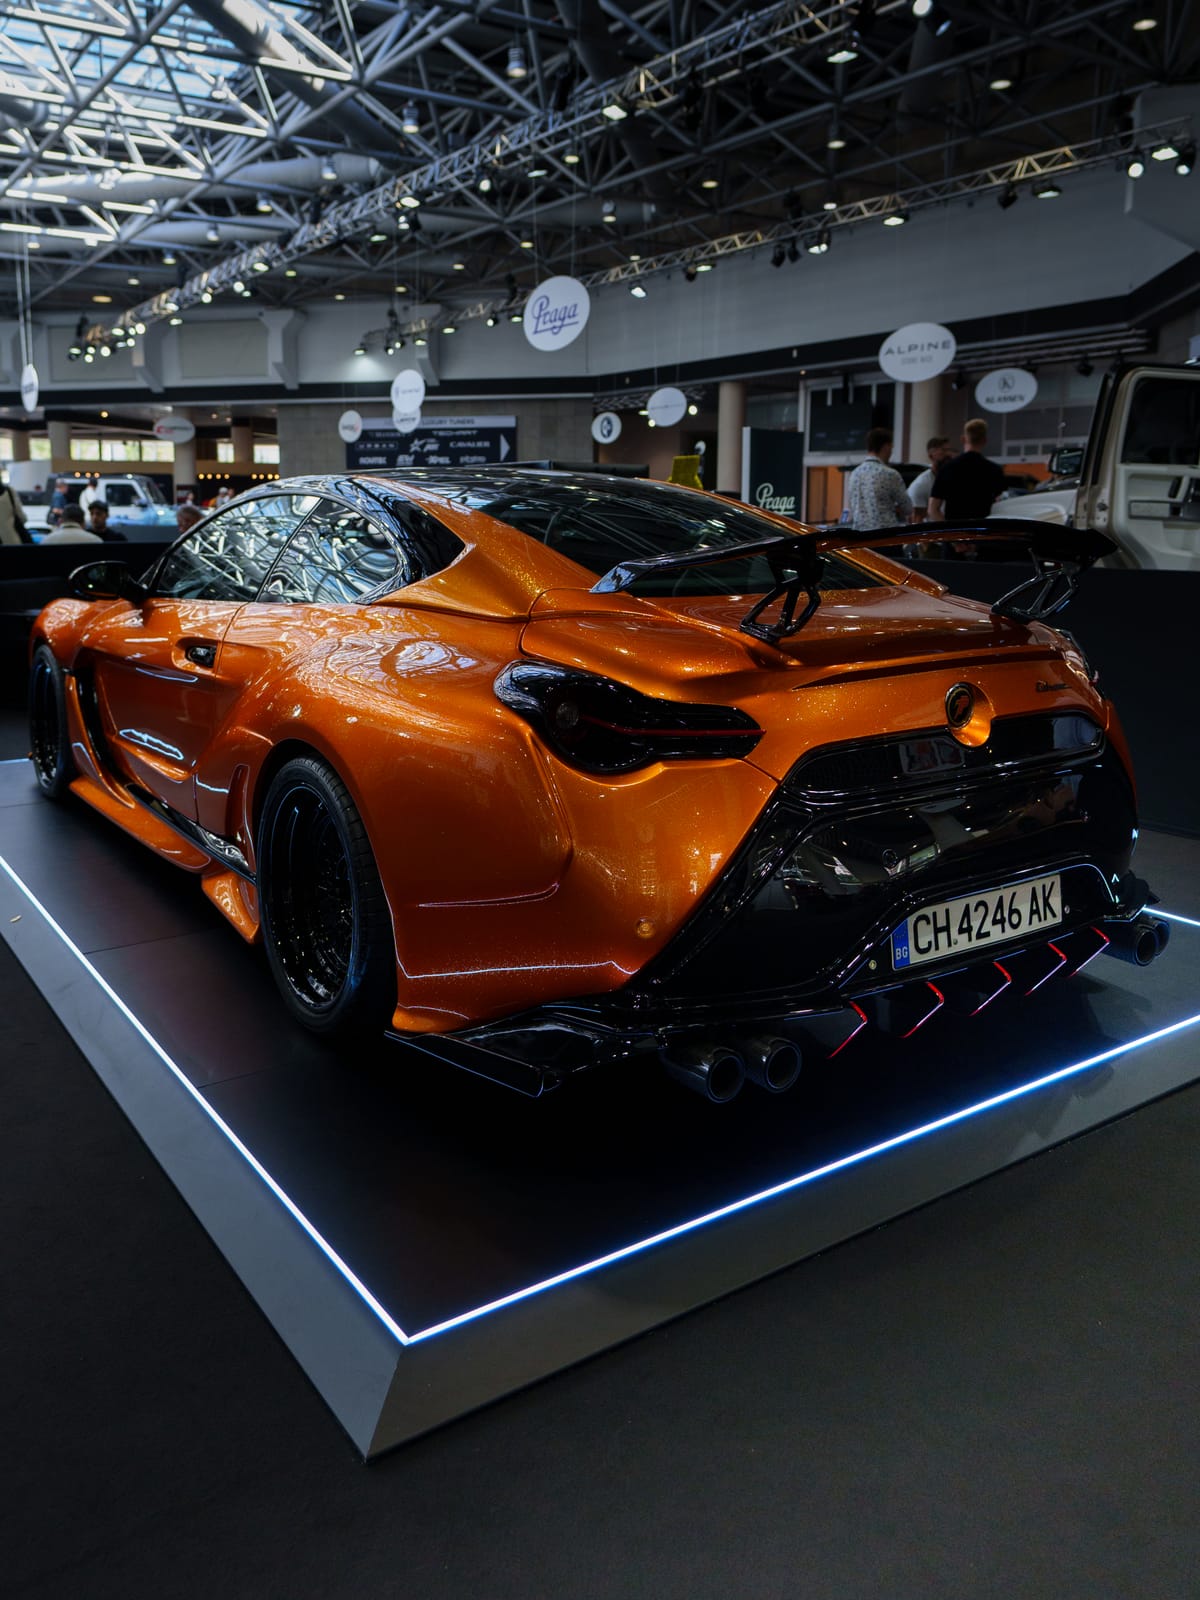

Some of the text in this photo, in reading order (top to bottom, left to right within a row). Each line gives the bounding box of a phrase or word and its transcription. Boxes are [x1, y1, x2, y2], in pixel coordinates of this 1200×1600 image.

[531, 294, 579, 336] Praga
[884, 340, 951, 356] ALPINE
[756, 482, 796, 515] Praga
[957, 891, 1022, 943] 4246
[1028, 881, 1058, 926] AK
[896, 946, 909, 961] BG
